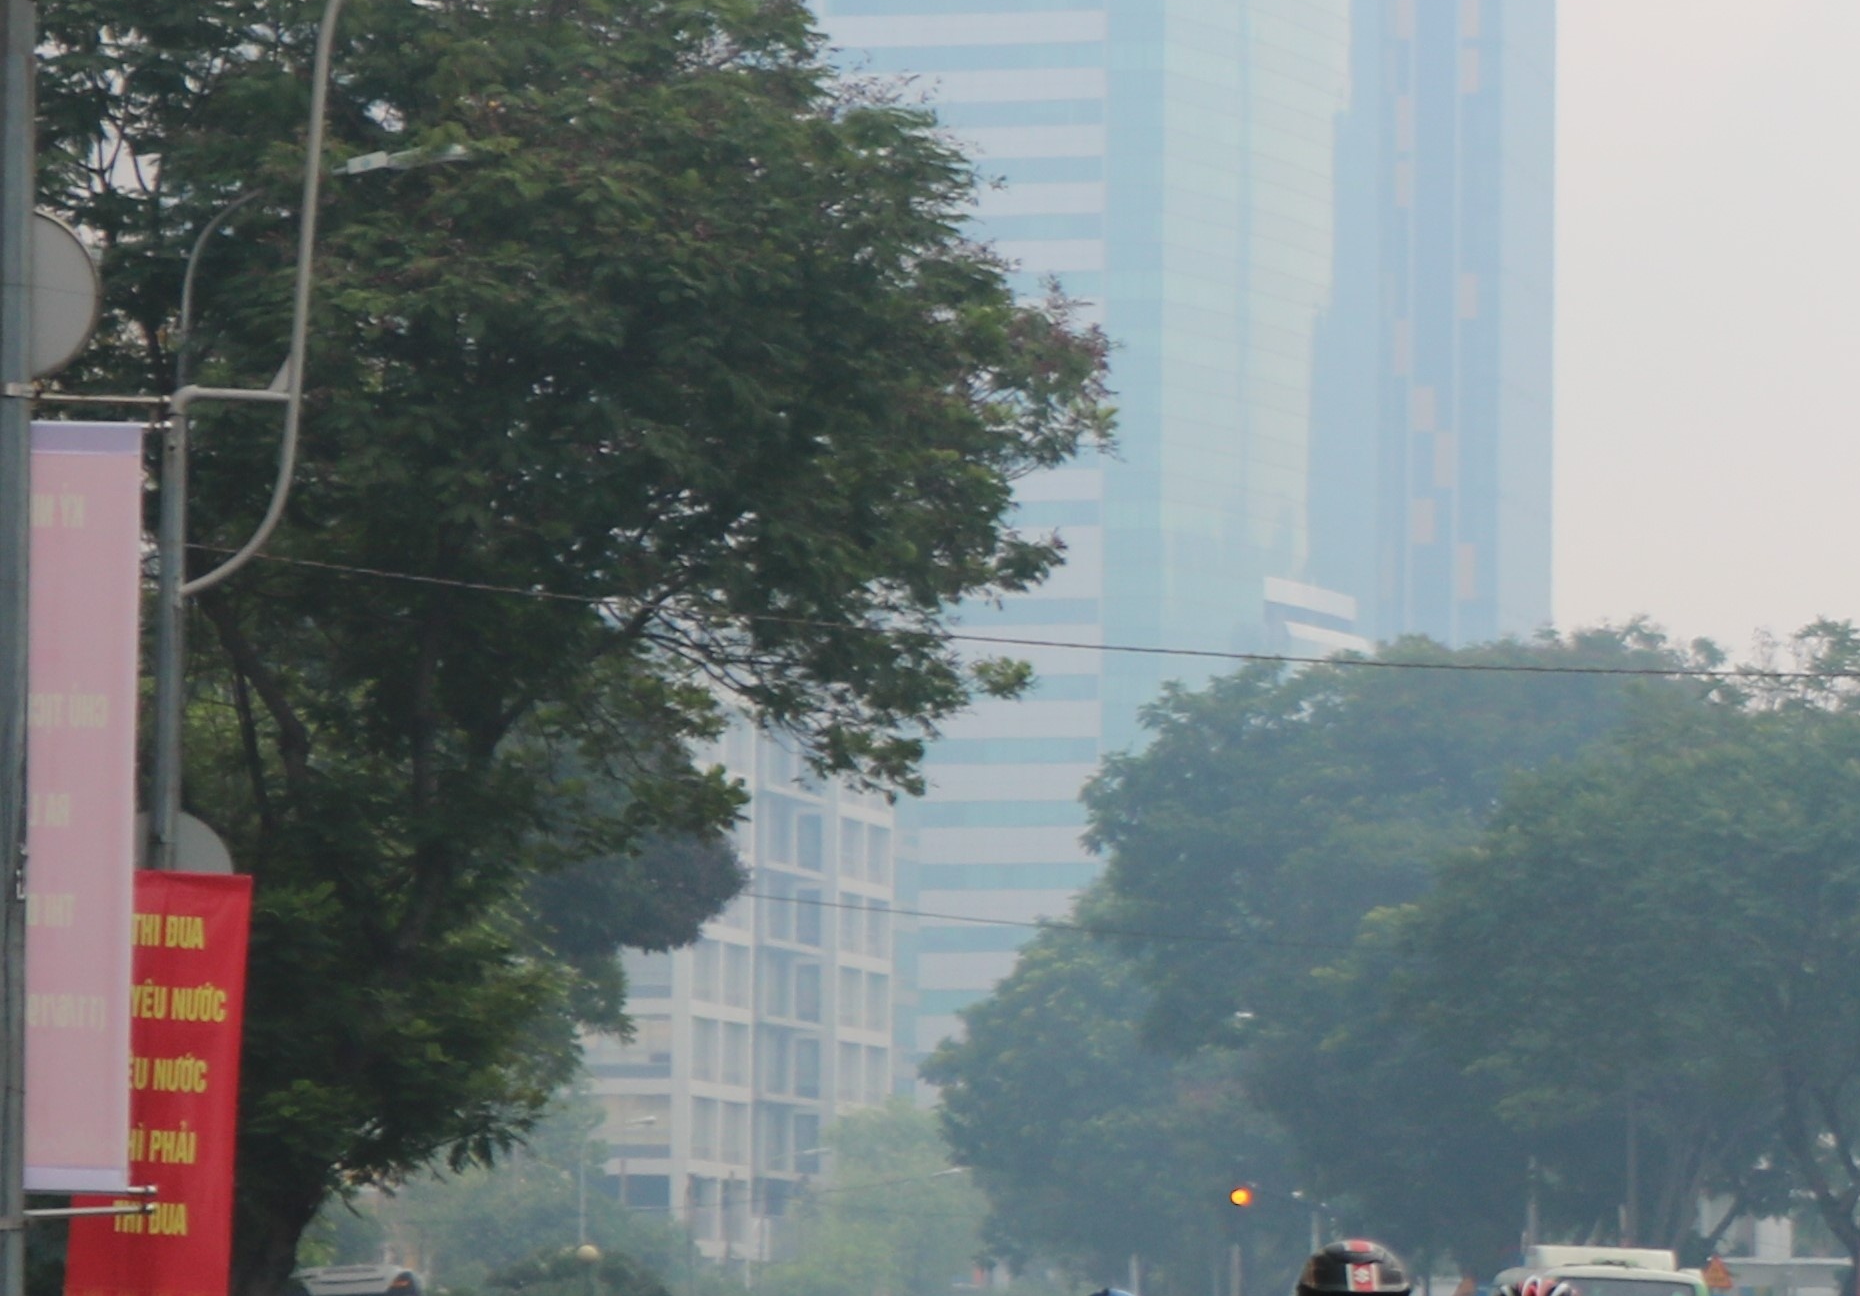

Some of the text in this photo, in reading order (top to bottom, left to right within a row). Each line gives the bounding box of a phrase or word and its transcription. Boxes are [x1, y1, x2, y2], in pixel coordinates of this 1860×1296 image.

[132, 913, 161, 946] THI
[131, 979, 227, 1022] YÊU NƯỚC
[154, 1053, 208, 1093] NƯỚC
[149, 1121, 197, 1164] PHẢI
[114, 1200, 143, 1233] THI
